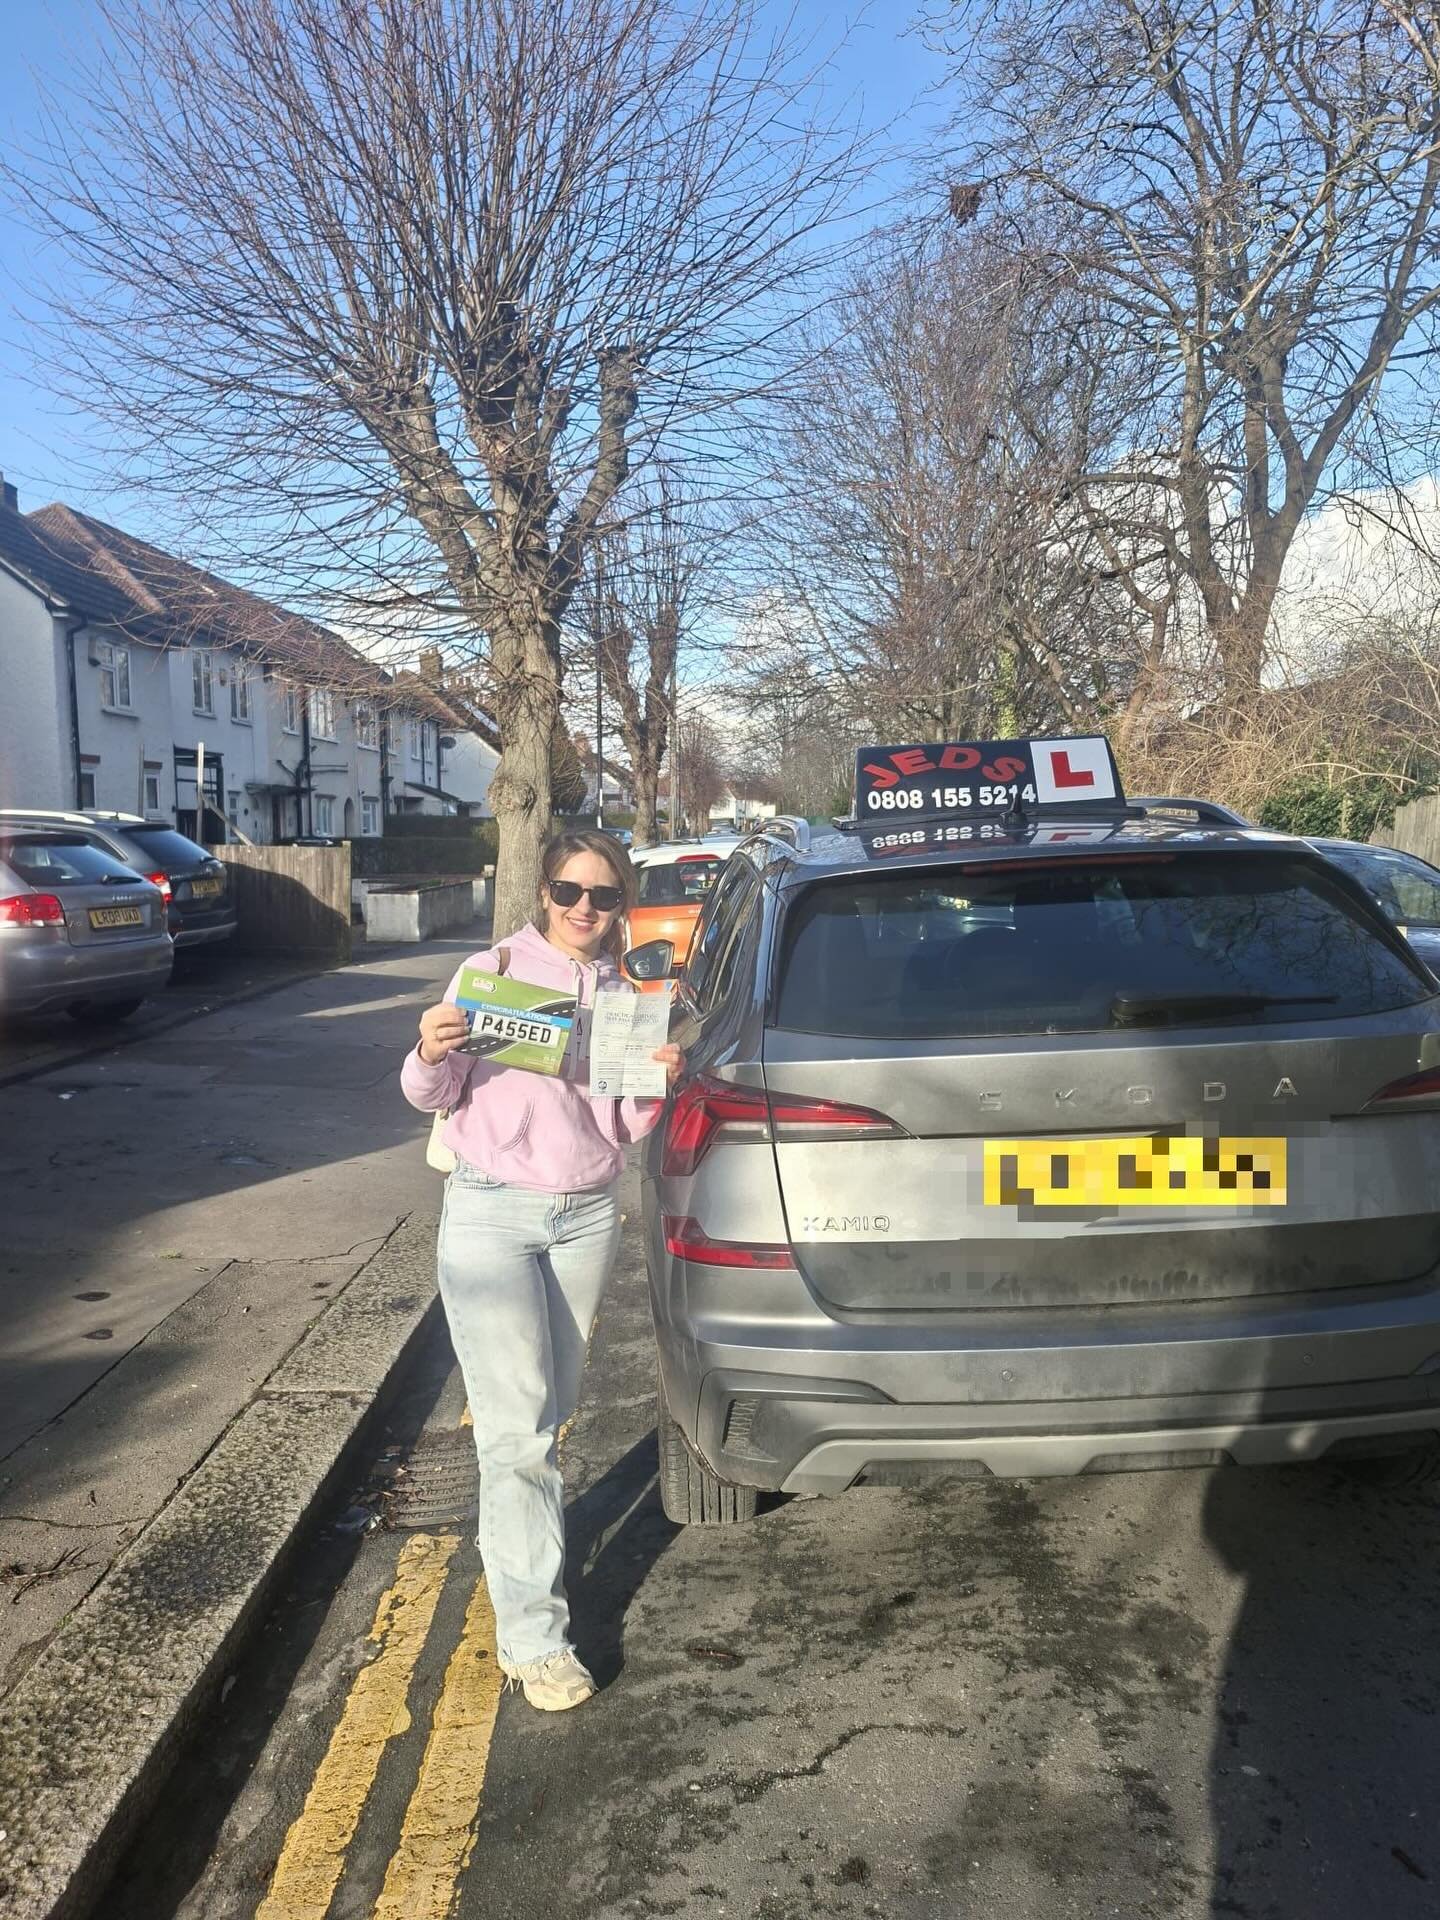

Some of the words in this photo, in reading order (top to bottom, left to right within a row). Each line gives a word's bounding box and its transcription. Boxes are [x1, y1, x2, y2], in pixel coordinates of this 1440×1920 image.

[863, 746, 1026, 788] JEDS
[1050, 751, 1095, 788] L
[867, 789, 924, 810] 0808
[931, 787, 972, 808] 155
[979, 783, 1037, 806] 5214
[802, 1214, 891, 1233] KAMIQ
